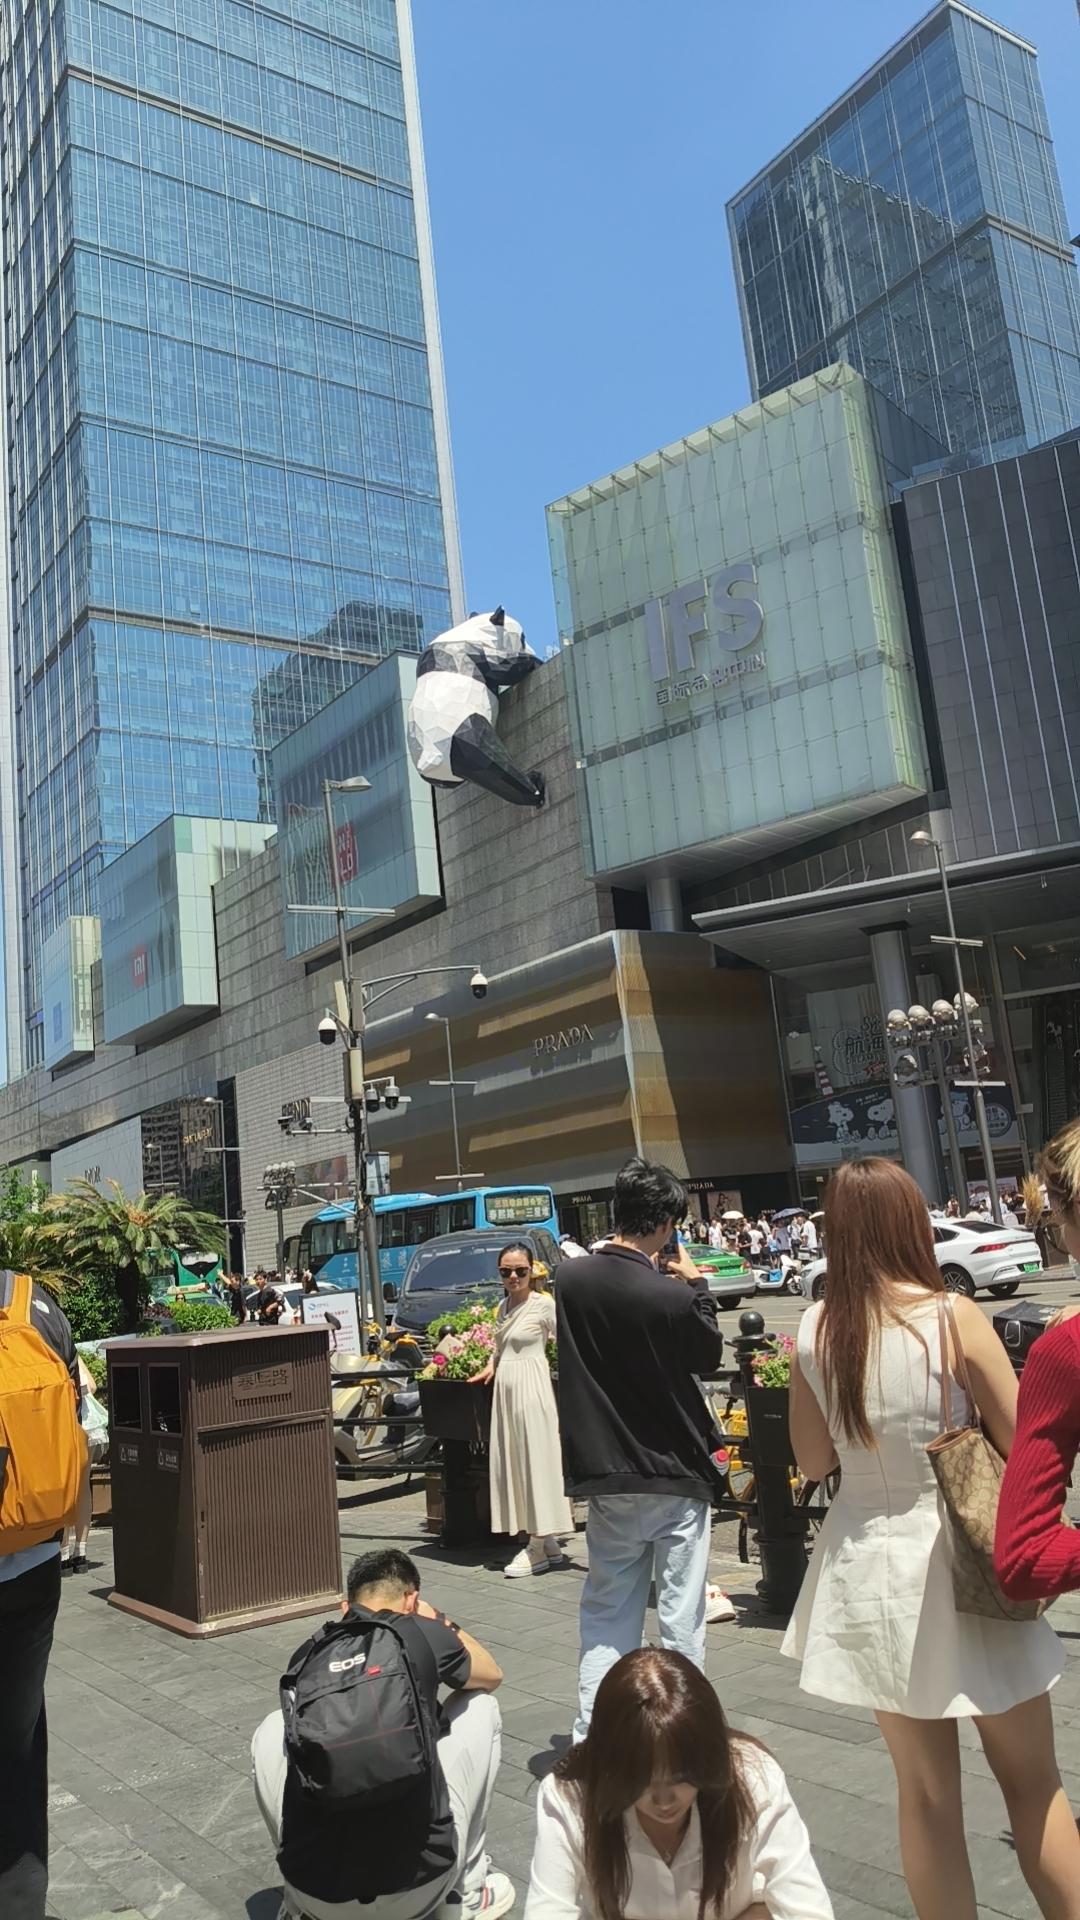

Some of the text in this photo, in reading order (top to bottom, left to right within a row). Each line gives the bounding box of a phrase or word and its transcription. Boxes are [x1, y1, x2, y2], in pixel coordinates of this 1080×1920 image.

[645, 564, 765, 683] IFS
[534, 1024, 594, 1057] PRADA
[329, 1653, 366, 1672] EOS
